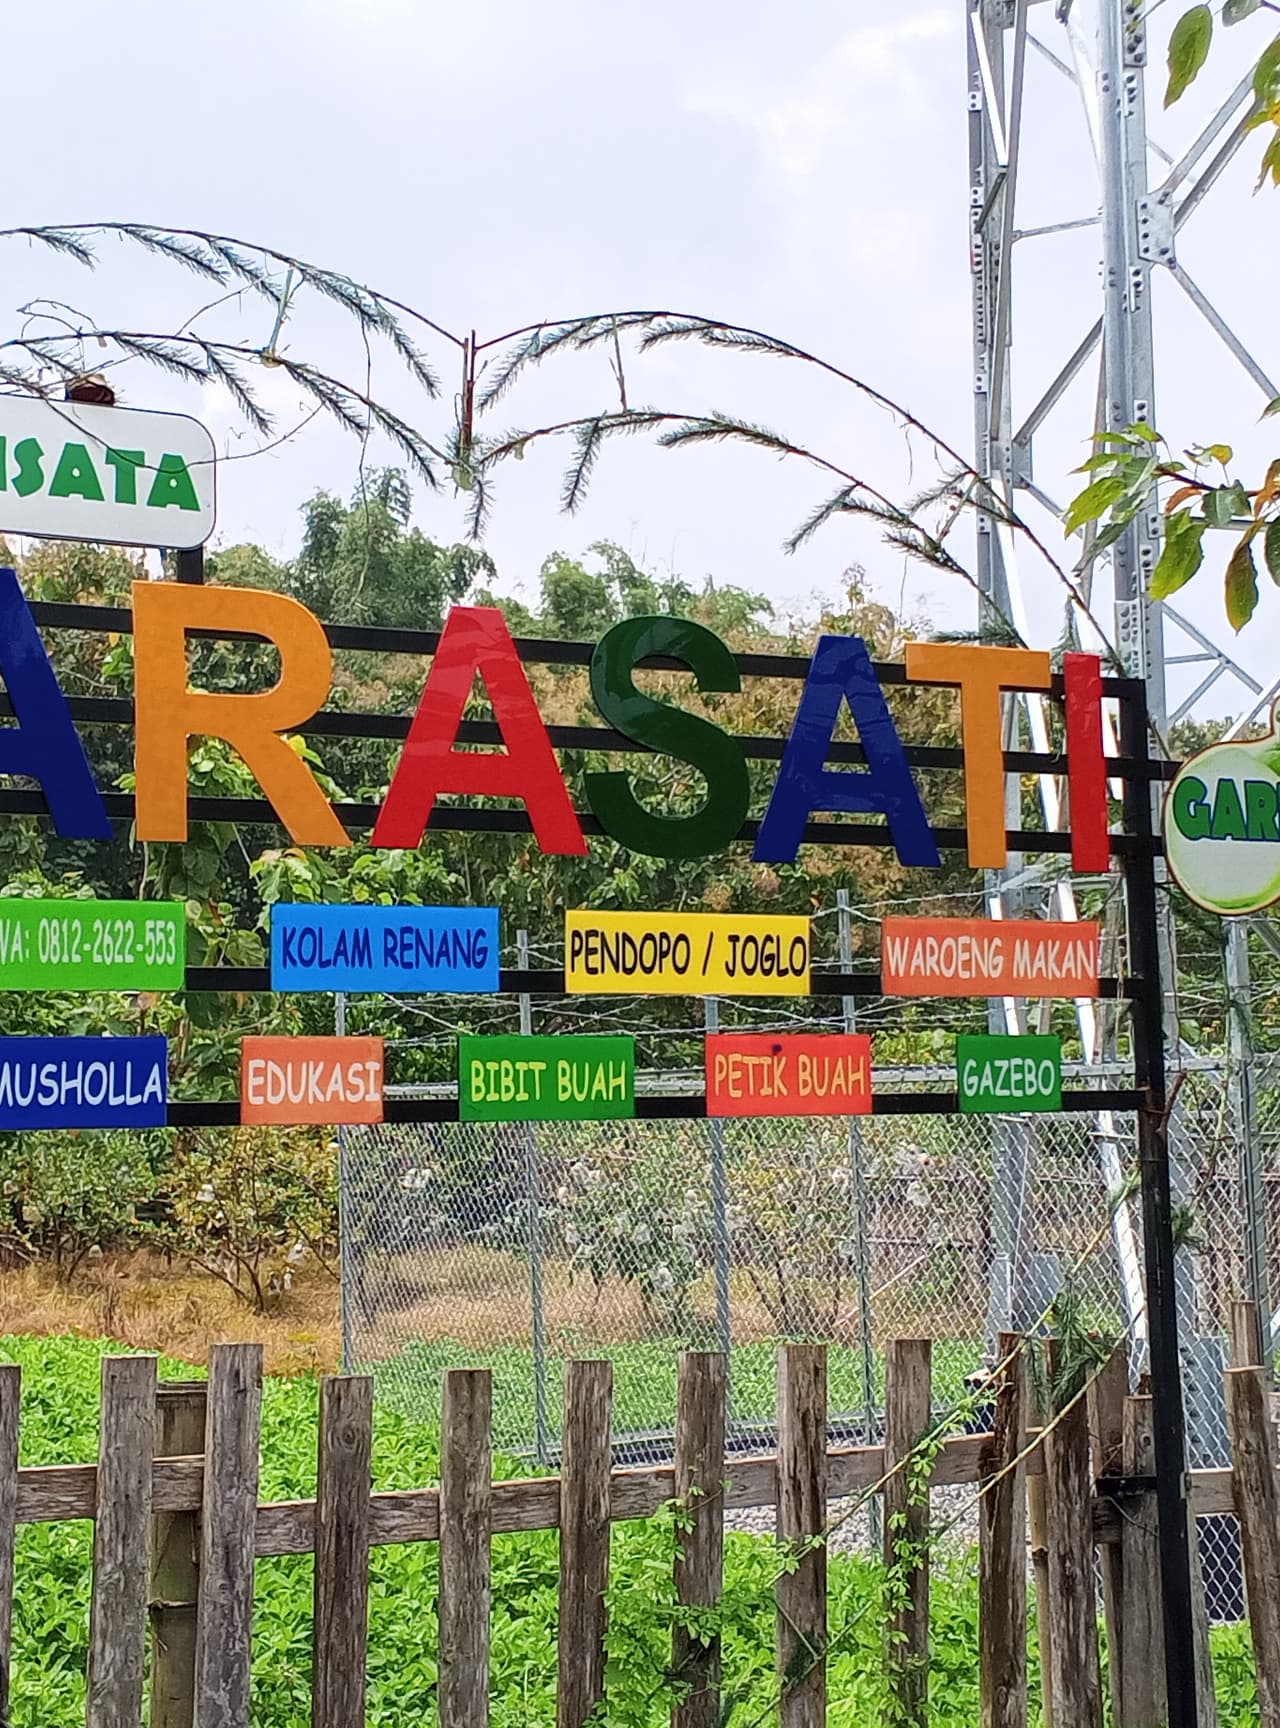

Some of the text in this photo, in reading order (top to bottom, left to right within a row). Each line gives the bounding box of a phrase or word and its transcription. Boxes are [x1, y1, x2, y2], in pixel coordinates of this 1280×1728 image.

[38, 918, 177, 966] 0812-2622-553
[282, 926, 489, 970] KOLAM RENANG
[570, 928, 808, 978] PENDOPO / JOGLO
[886, 935, 1097, 980] WAROENG MAKAN
[247, 1059, 381, 1105] EDUKASI
[470, 1060, 627, 1103] BIBIT BUAH
[713, 1053, 867, 1099] PETIK BUAH
[962, 1058, 1057, 1098] GAZEBO
